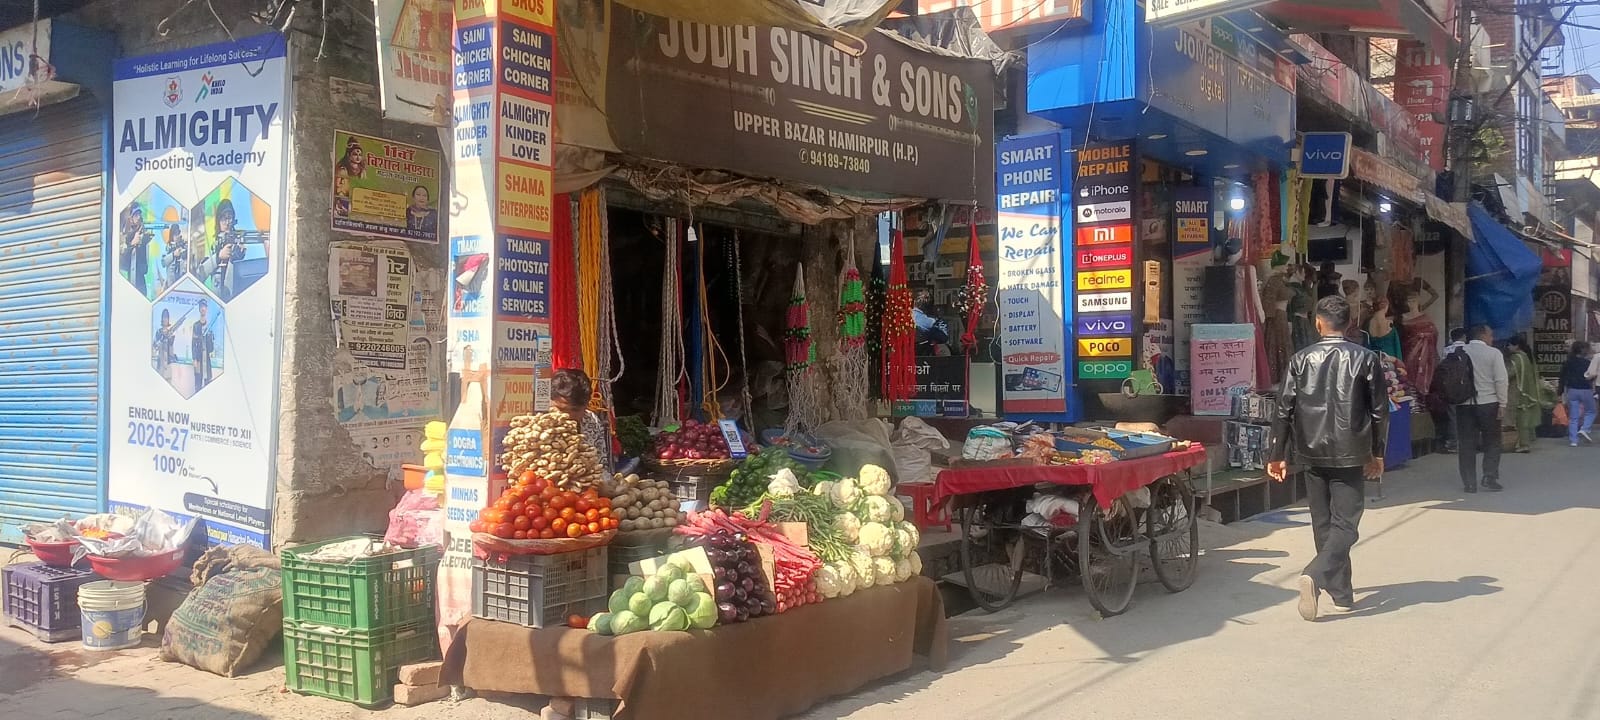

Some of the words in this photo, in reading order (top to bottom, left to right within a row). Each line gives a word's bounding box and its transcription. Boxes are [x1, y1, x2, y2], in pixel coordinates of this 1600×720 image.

[1151, 0, 1169, 12] SALE
[463, 27, 485, 45] SAINI
[512, 28, 542, 49] SAINI
[0, 41, 24, 81] NS
[160, 58, 188, 71] Learning
[189, 57, 198, 65] for
[200, 53, 227, 65] Lifelong
[455, 47, 492, 66] CHICKEN
[502, 46, 551, 72] CHICKEN
[456, 70, 491, 87] CORNER
[504, 68, 549, 92] CORNER
[658, 20, 758, 76] JODH
[770, 26, 862, 100] SINGH
[872, 54, 891, 107] &
[900, 62, 963, 124] SONS
[211, 87, 223, 95] INDIA
[1200, 73, 1225, 103] digital
[454, 101, 491, 122] ALMIGHTY
[501, 100, 551, 128] ALMIGHTY
[120, 102, 278, 153] ALMIGHTY
[456, 125, 487, 141] KINDER
[505, 124, 547, 146] KINDER
[733, 110, 780, 138] UPPER
[784, 118, 825, 147] BAZAR
[828, 127, 890, 157] HAMIRPUR
[892, 143, 919, 166] (H.P.)
[1420, 137, 1433, 146] RY
[461, 143, 482, 158] LOVE
[511, 143, 540, 161] LOVE
[1000, 145, 1054, 166] SMART
[1078, 145, 1130, 163] MOBILE
[1304, 148, 1342, 160] vivo
[135, 155, 194, 172] Shooting
[198, 149, 266, 167] Academy
[810, 150, 870, 174] 94189-73840
[1080, 161, 1128, 177] REPAIR
[504, 174, 545, 197] SHAMA
[1003, 168, 1053, 187] PHONE
[1001, 188, 1056, 209] REPAIR
[1090, 184, 1129, 196] iPhone
[500, 202, 549, 222] ENTERPRISES
[1093, 206, 1126, 215] motorola
[1175, 200, 1209, 213] SMART
[1001, 225, 1023, 242] We
[1030, 222, 1059, 238] Can
[457, 239, 480, 254] THAKU
[506, 238, 542, 255] THAKUR
[1004, 243, 1056, 260] Repair
[1092, 253, 1127, 262] ONEPLUS
[498, 257, 549, 276] PHOTOSTAT
[1007, 268, 1033, 278] BROKEN
[1035, 266, 1056, 276] GLASS
[503, 278, 510, 291] &
[512, 278, 544, 295] ONLINE
[1007, 281, 1030, 291] WATER
[1031, 279, 1059, 290] DAMAGE
[1083, 273, 1125, 286] realme
[1007, 296, 1029, 305] TOUCH
[1081, 297, 1128, 307] SAMSUNG
[1008, 310, 1035, 319] DISPLAY
[1008, 323, 1037, 333] BATTERY
[1085, 319, 1125, 331] vivo
[1546, 318, 1569, 331] AIR
[507, 327, 538, 341] USHA
[1009, 336, 1043, 347] SOFTWARE
[497, 346, 538, 361] ORNAMEN
[1089, 342, 1119, 353] POCO
[1008, 355, 1029, 363] Quick
[1030, 354, 1054, 363] Repair
[1083, 363, 1127, 375] oppo
[505, 381, 534, 394] MONIK
[128, 406, 165, 422] ENROLL
[167, 411, 190, 425] NOW
[498, 400, 534, 414] JEWELL
[127, 421, 189, 452] 2026-27
[190, 421, 226, 435] NURSERY
[228, 427, 238, 438] TO
[240, 429, 252, 440] XII
[190, 433, 202, 441] ARTS
[203, 436, 230, 446] COMMERCE
[232, 440, 252, 450] SCIENCE
[452, 436, 477, 450] DOGRA
[153, 454, 188, 477] 100%
[451, 487, 478, 502] MINHAS
[217, 509, 235, 519] National
[236, 512, 247, 523] Level
[248, 516, 265, 528] Players
[447, 507, 465, 521] SEEDS
[466, 509, 479, 523] SHO
[448, 537, 472, 553] DEE
[441, 555, 472, 570] ELECTRO
